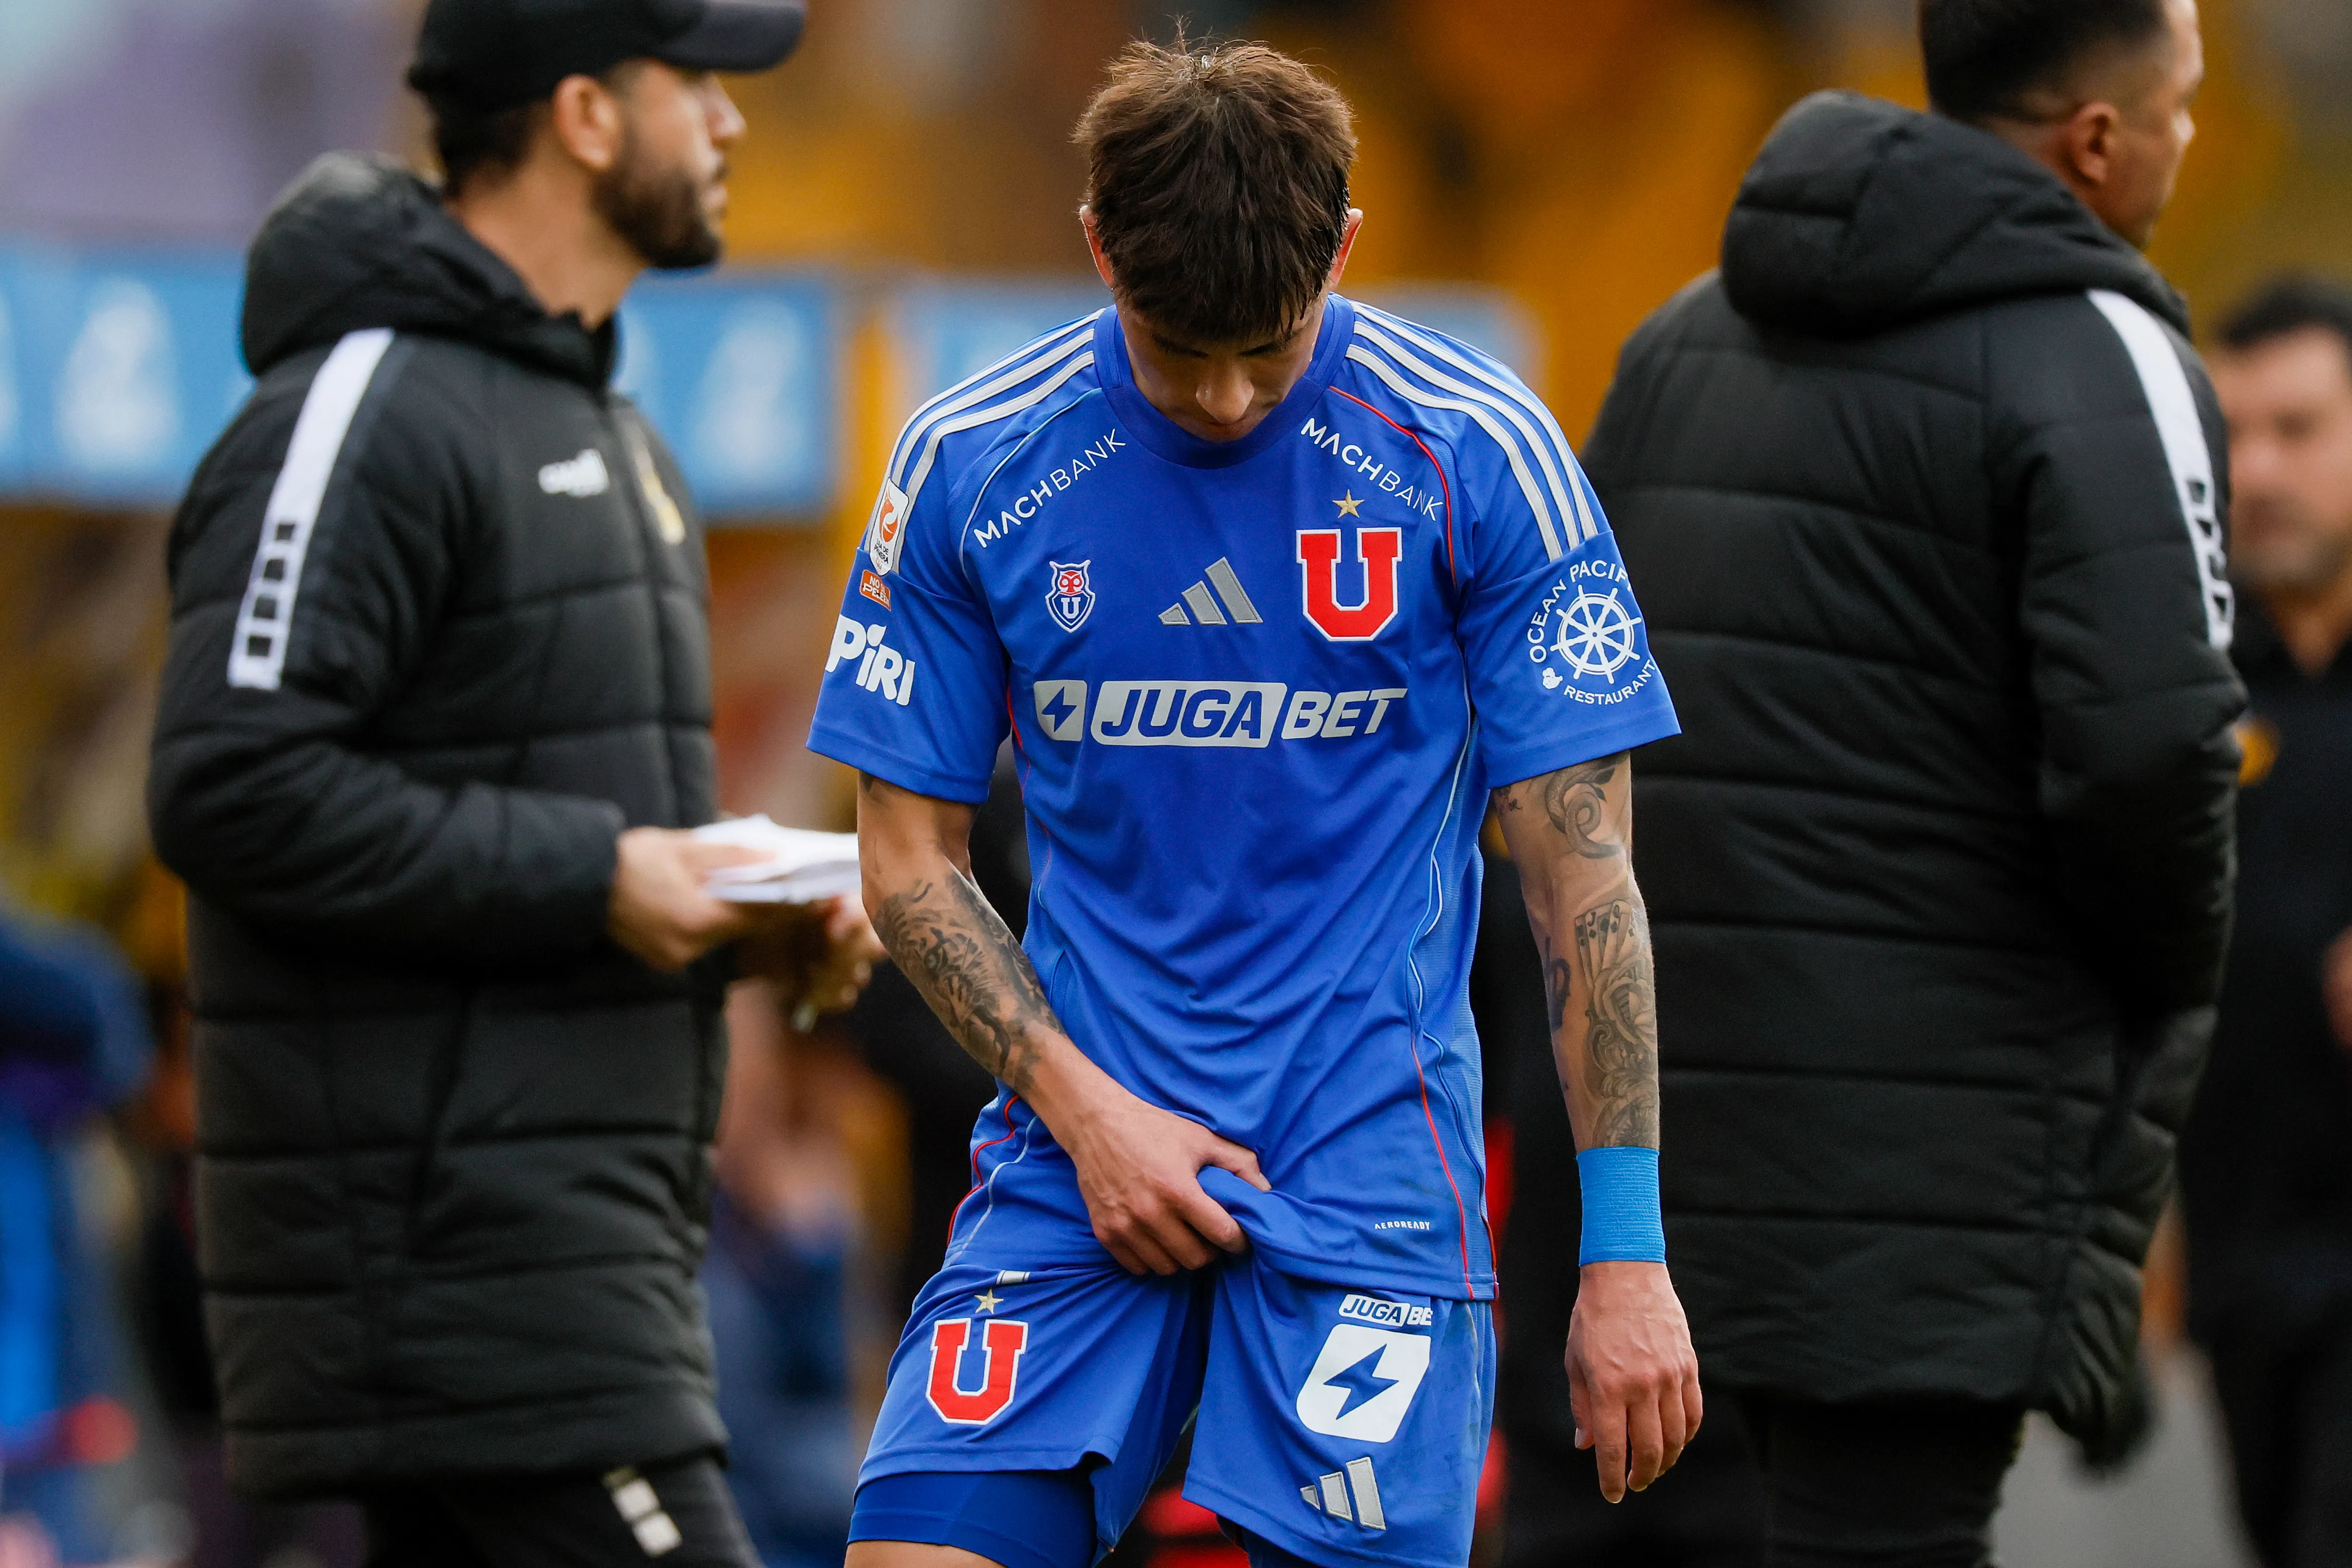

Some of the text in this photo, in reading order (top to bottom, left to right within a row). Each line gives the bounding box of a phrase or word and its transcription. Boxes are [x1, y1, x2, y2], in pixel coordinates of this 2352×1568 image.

[883, 546, 889, 555] DE
[869, 575, 880, 589] NO
[1296, 527, 1403, 642] U
[1061, 597, 1081, 619] U
[1527, 578, 1567, 663] OCEAN
[1563, 659, 1655, 705] RESTAURANT
[1374, 1221, 1430, 1230] AEROREADY
[925, 1318, 1029, 1425] U
